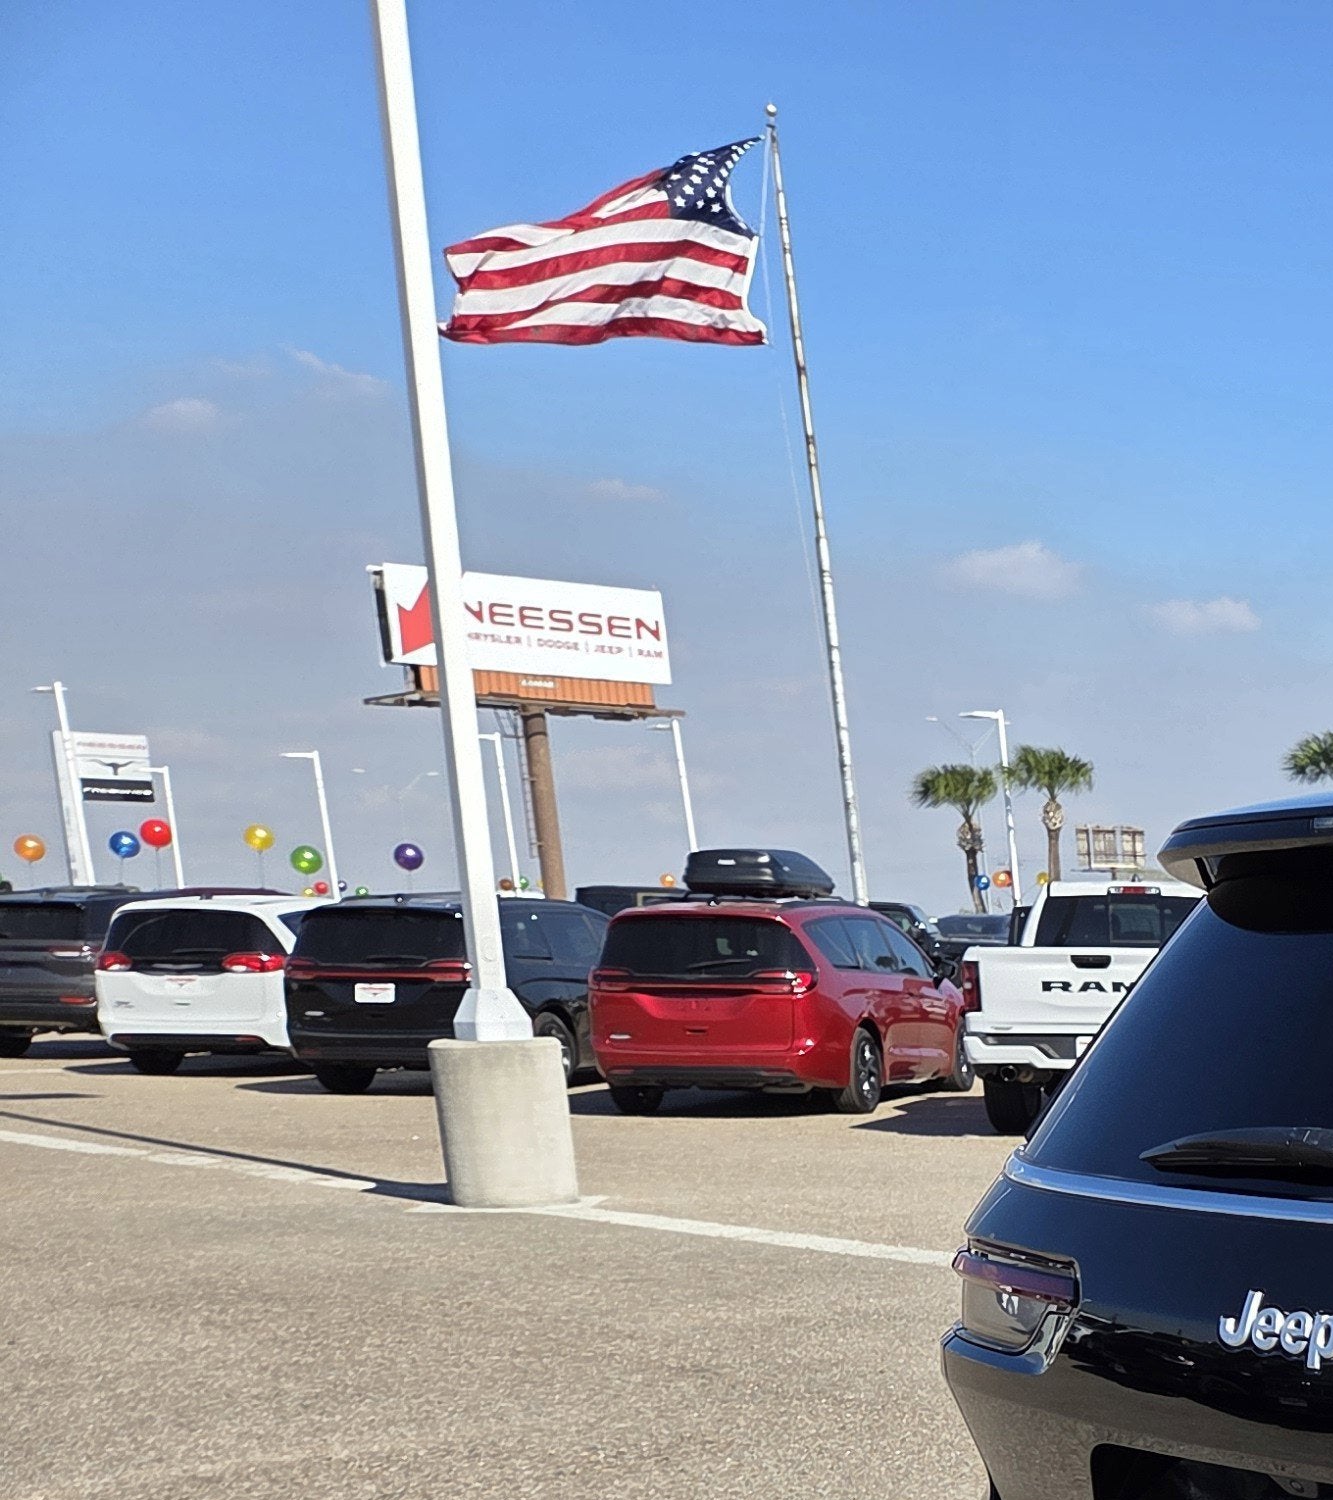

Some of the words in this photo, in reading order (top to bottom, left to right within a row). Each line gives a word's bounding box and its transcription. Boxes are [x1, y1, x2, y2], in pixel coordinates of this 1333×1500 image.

[463, 600, 661, 641] NEESSEN
[467, 632, 522, 645] RYSLER
[537, 638, 580, 651] DODGE
